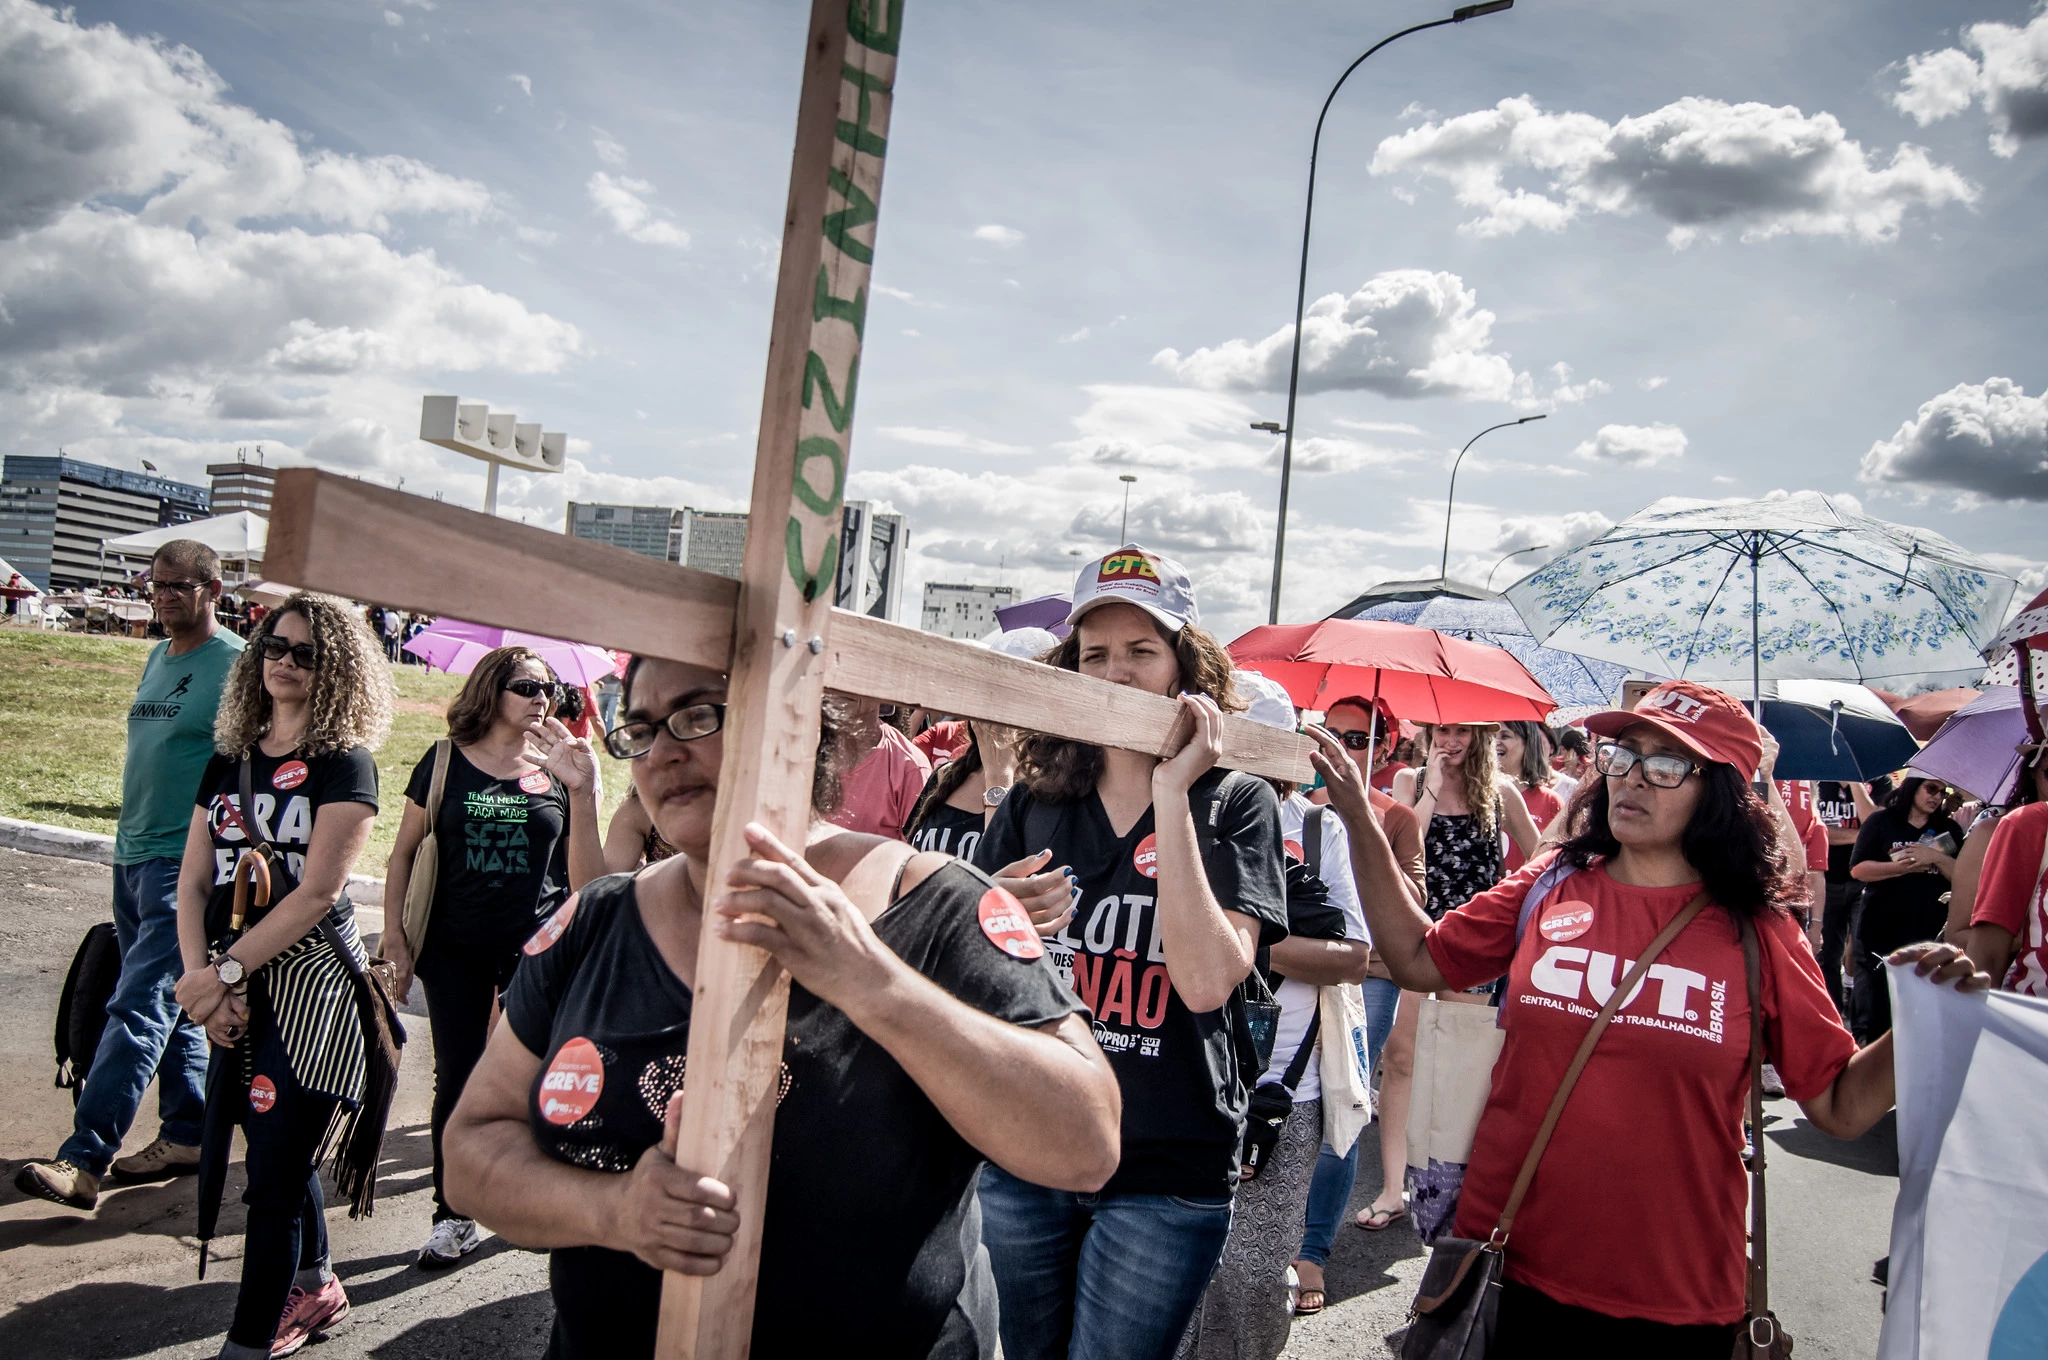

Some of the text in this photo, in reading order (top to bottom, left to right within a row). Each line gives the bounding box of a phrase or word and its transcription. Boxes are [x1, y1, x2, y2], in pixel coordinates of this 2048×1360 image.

[1102, 555, 1157, 578] CTB
[130, 703, 181, 718] UNNING
[273, 767, 307, 784] GREVE
[467, 792, 529, 805] TENHA MENOS
[467, 806, 529, 819] FAÇA MAIS
[464, 822, 530, 848] SEJA
[1541, 912, 1592, 931] GREVE
[1071, 948, 1172, 1029] NÃO
[1530, 945, 1706, 1020] CUT
[1710, 979, 1726, 1035] BRASIL
[1520, 994, 1723, 1044] CENTRAL ÚNICA OS TRABALHADORES
[251, 1088, 275, 1100] GREVE
[543, 1071, 601, 1094] GREVE
